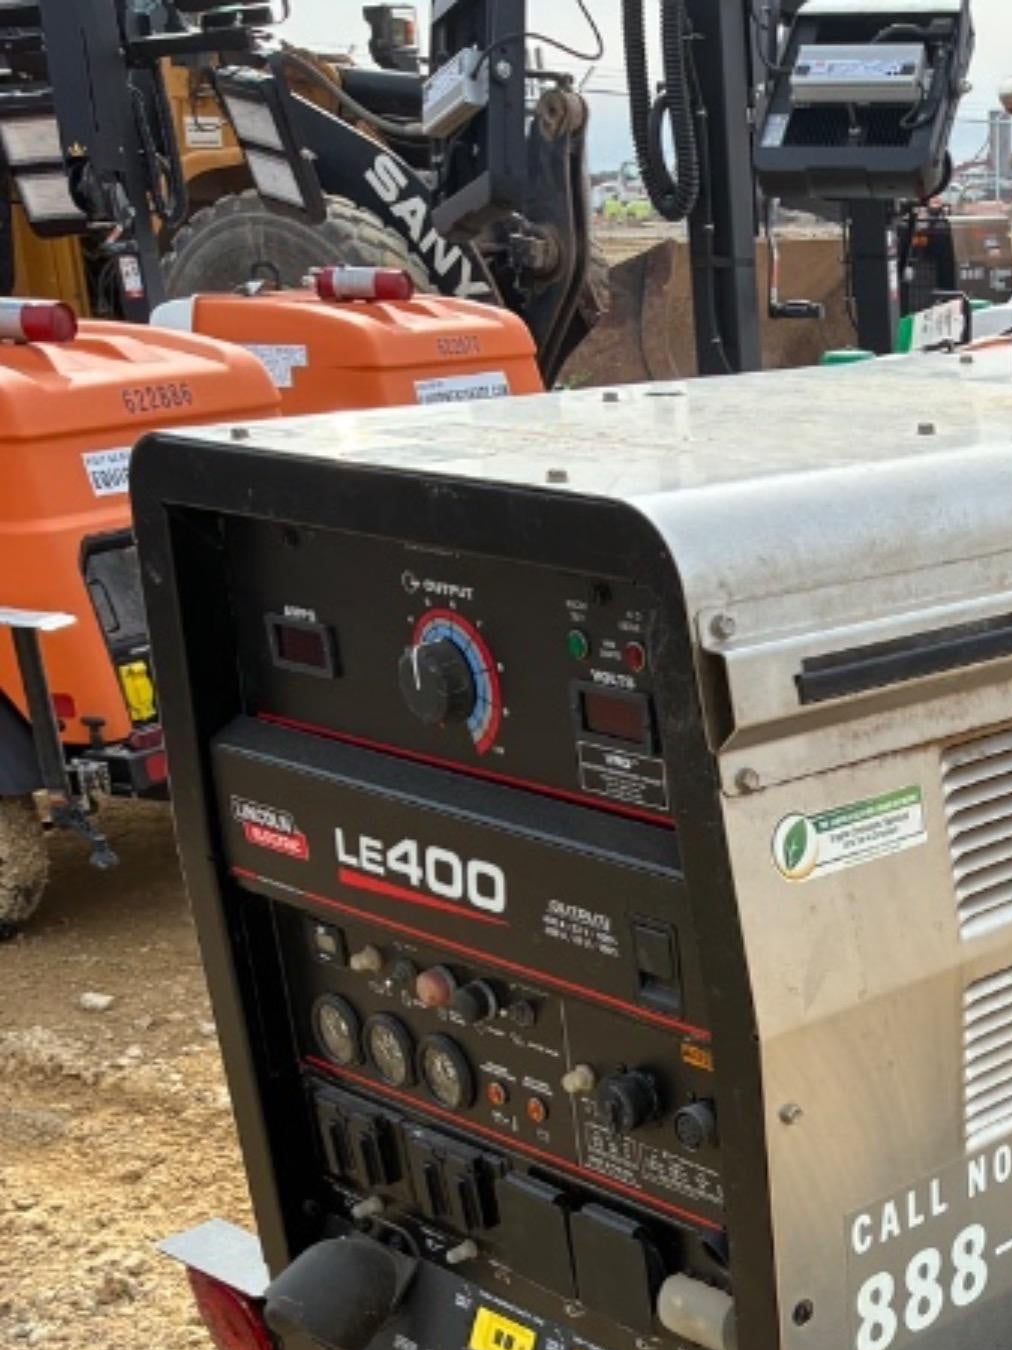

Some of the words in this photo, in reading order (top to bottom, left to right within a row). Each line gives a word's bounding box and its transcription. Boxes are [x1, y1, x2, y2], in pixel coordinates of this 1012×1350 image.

[364, 153, 493, 298] SANY
[333, 826, 507, 914] LE400
[851, 1178, 948, 1256] CALL
